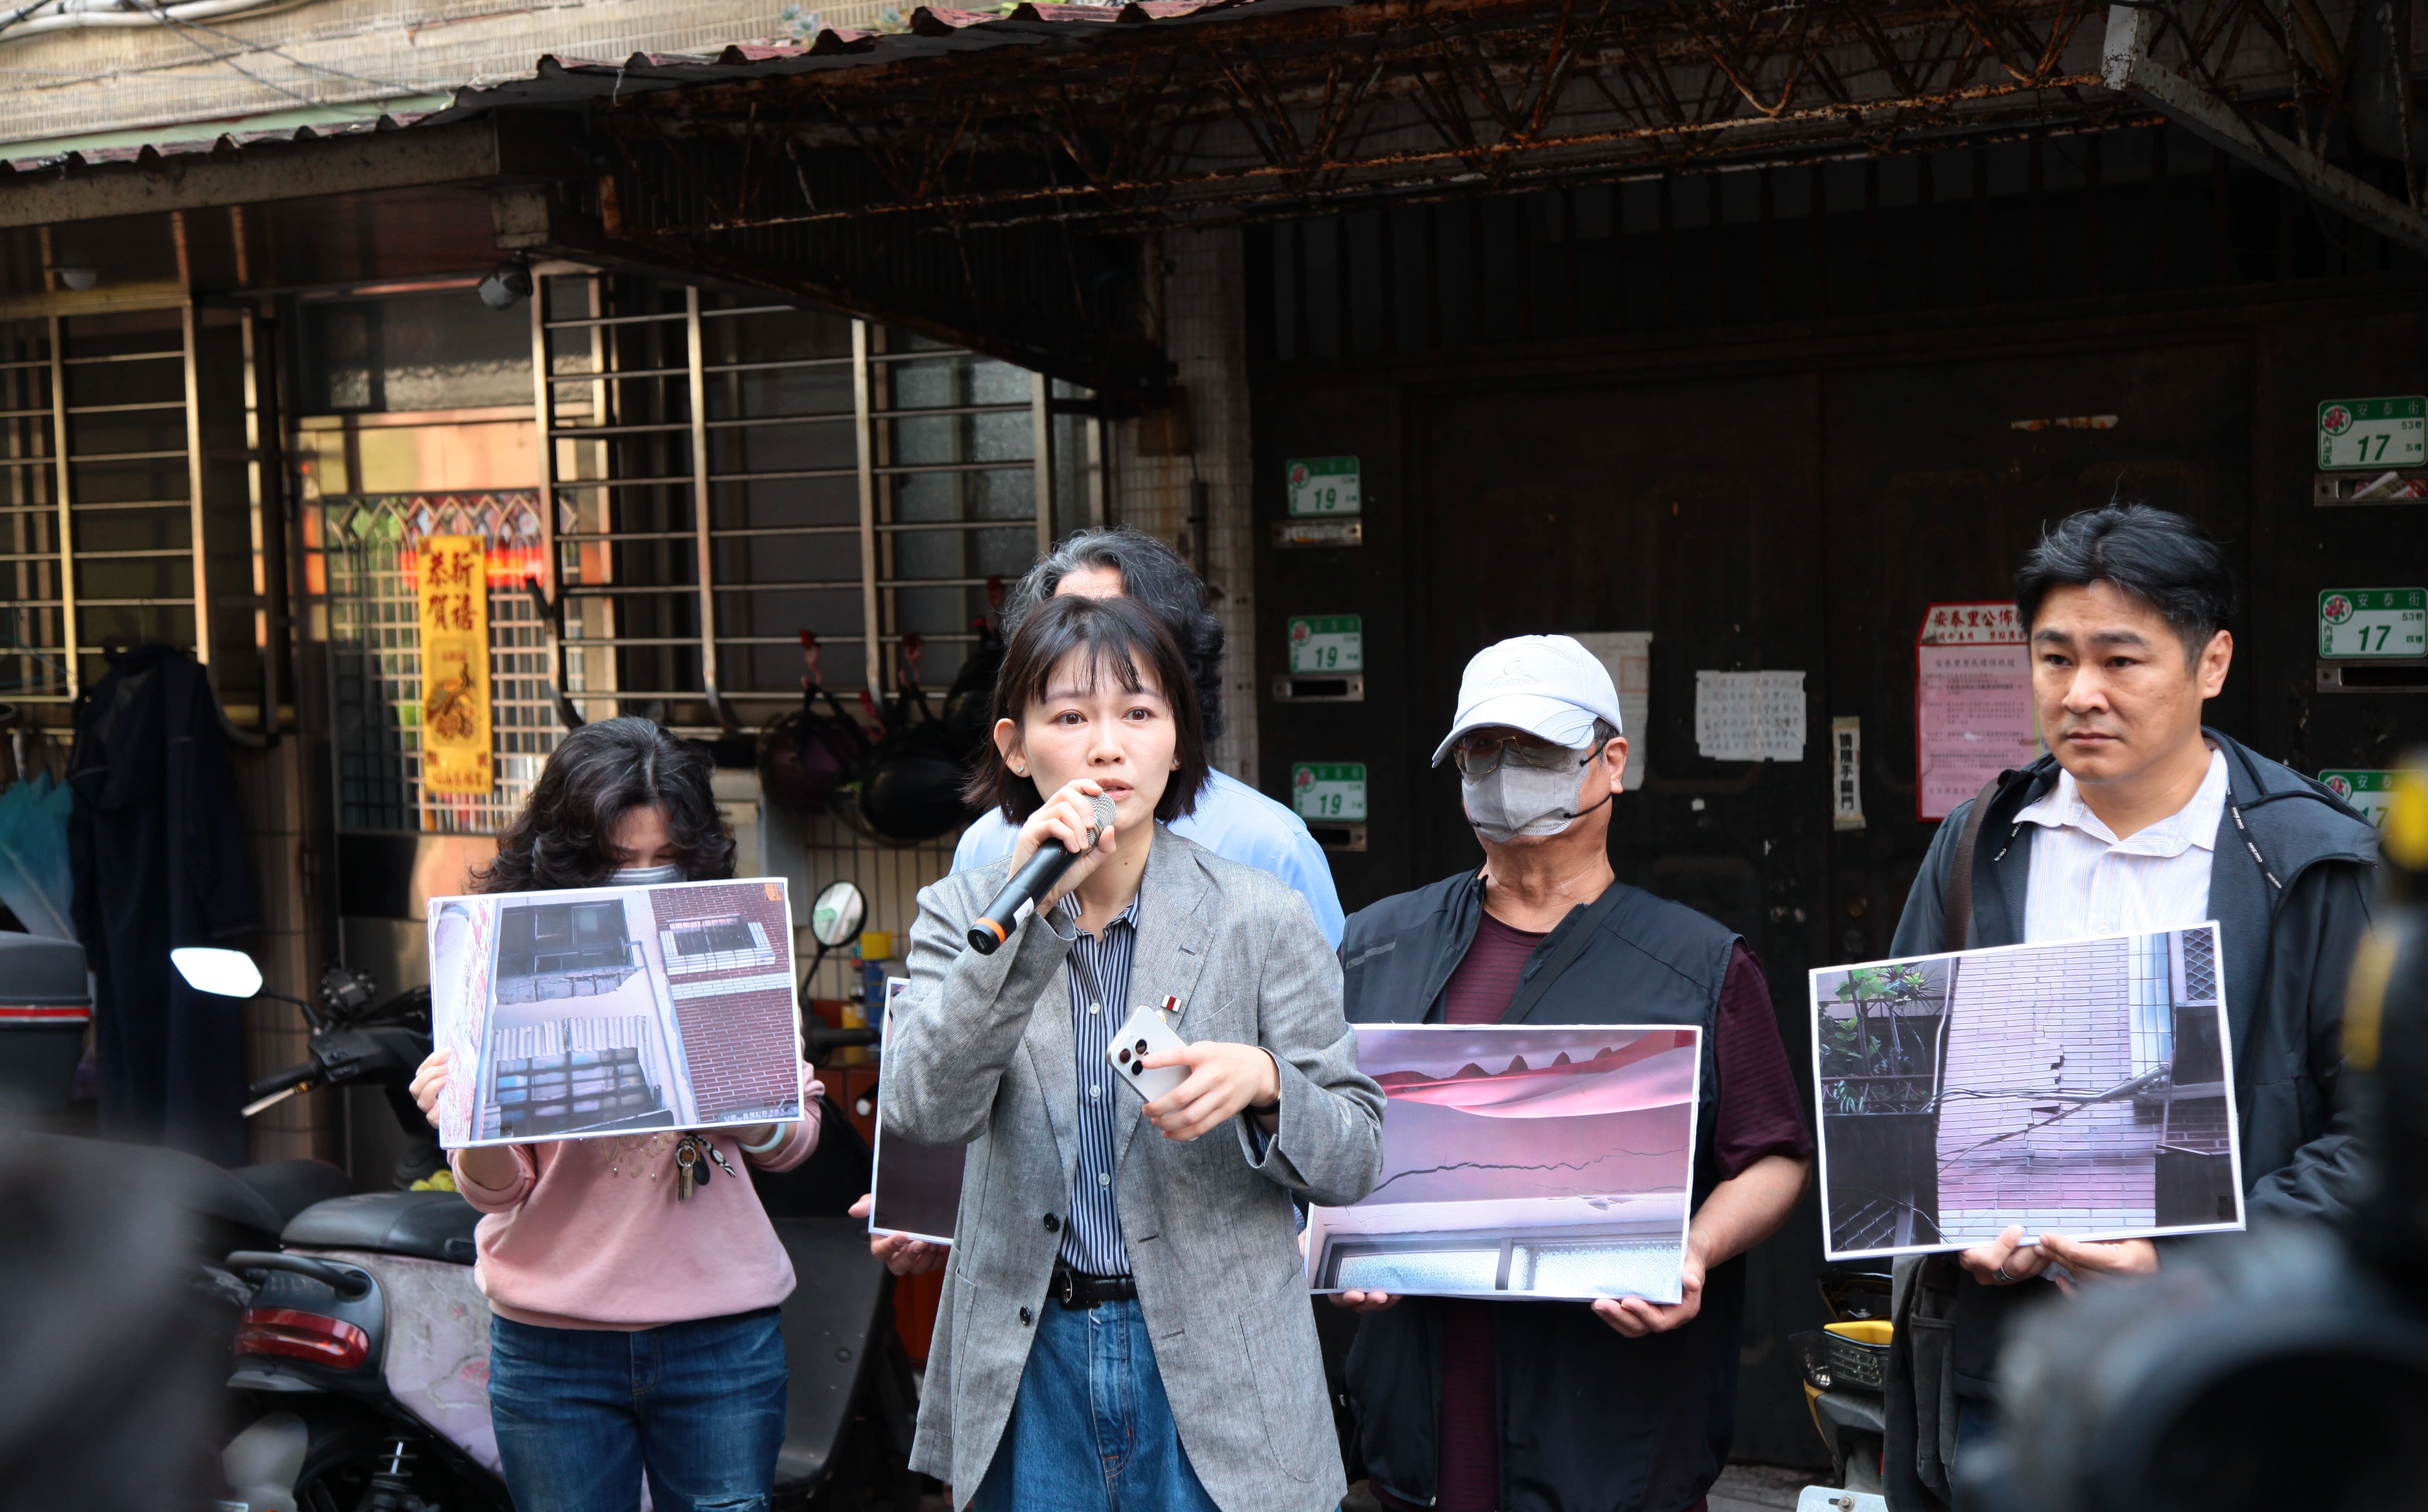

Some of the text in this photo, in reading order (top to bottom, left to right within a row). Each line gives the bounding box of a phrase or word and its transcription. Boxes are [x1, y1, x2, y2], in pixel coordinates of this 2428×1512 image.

[2358, 400, 2419, 417] 安泰街
[2402, 421, 2422, 430] 53巷
[2358, 434, 2391, 462] 17
[1314, 487, 1336, 510] 19
[2358, 592, 2419, 607] 安泰街
[2402, 613, 2423, 621] 53巷
[2359, 625, 2391, 651] 17
[1315, 645, 1338, 667] 19
[1839, 732, 1854, 810] 請隨手關門
[2358, 774, 2393, 789] 安泰
[1319, 793, 1342, 815] 19
[2232, 807, 2240, 819] NIKE
[2248, 842, 2257, 853] NIKE
